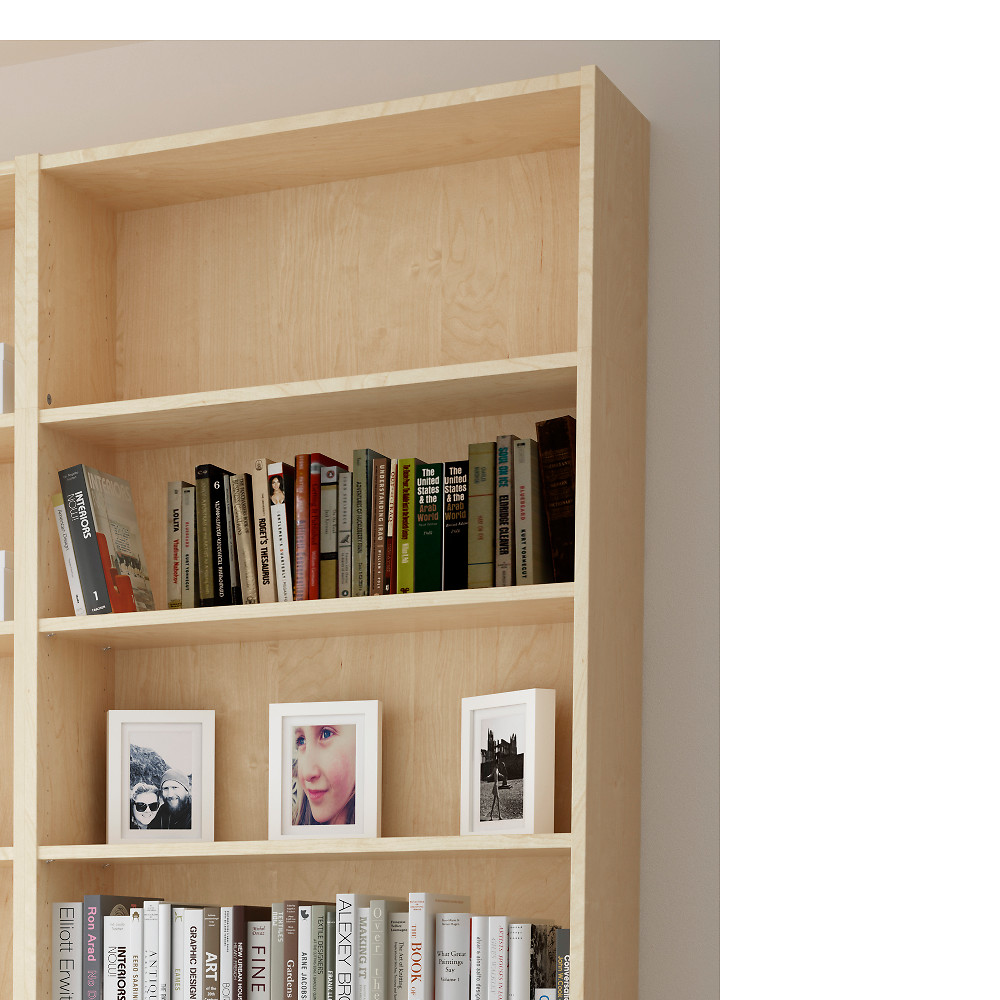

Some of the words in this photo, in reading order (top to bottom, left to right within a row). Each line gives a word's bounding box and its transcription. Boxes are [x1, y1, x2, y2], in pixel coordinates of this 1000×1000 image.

[499, 447, 508, 464] SOUL
[417, 476, 440, 487] United
[422, 468, 435, 476] The
[444, 474, 467, 485] United
[449, 467, 462, 475] The
[499, 465, 508, 475] ON
[499, 476, 509, 488] ICE
[417, 486, 440, 495] States
[425, 495, 437, 503] the
[444, 484, 467, 493] States
[75, 491, 91, 539] INTERIORS
[417, 512, 438, 522] World
[419, 503, 437, 513] Arab
[444, 510, 467, 520] World
[446, 502, 464, 511] Arab
[499, 494, 509, 527] ELDRIDGE
[258, 518, 268, 545] ROGET'S
[499, 527, 509, 556] CLEAVER
[260, 546, 270, 586] THESAURUS
[59, 907, 75, 953] Elliott
[87, 906, 97, 930] Ron
[338, 898, 352, 967] ALEXEY
[358, 916, 367, 965] MAKING
[87, 933, 97, 962] Arad
[189, 926, 197, 965] GRAPHIC
[107, 946, 118, 977] NOW!
[205, 952, 218, 981] ART
[251, 946, 266, 992] FINE
[410, 942, 422, 984] BOOK
[87, 970, 97, 987] No
[189, 967, 197, 1000] DESIGN
[286, 959, 295, 999] Gardens
[358, 968, 367, 980] IT
